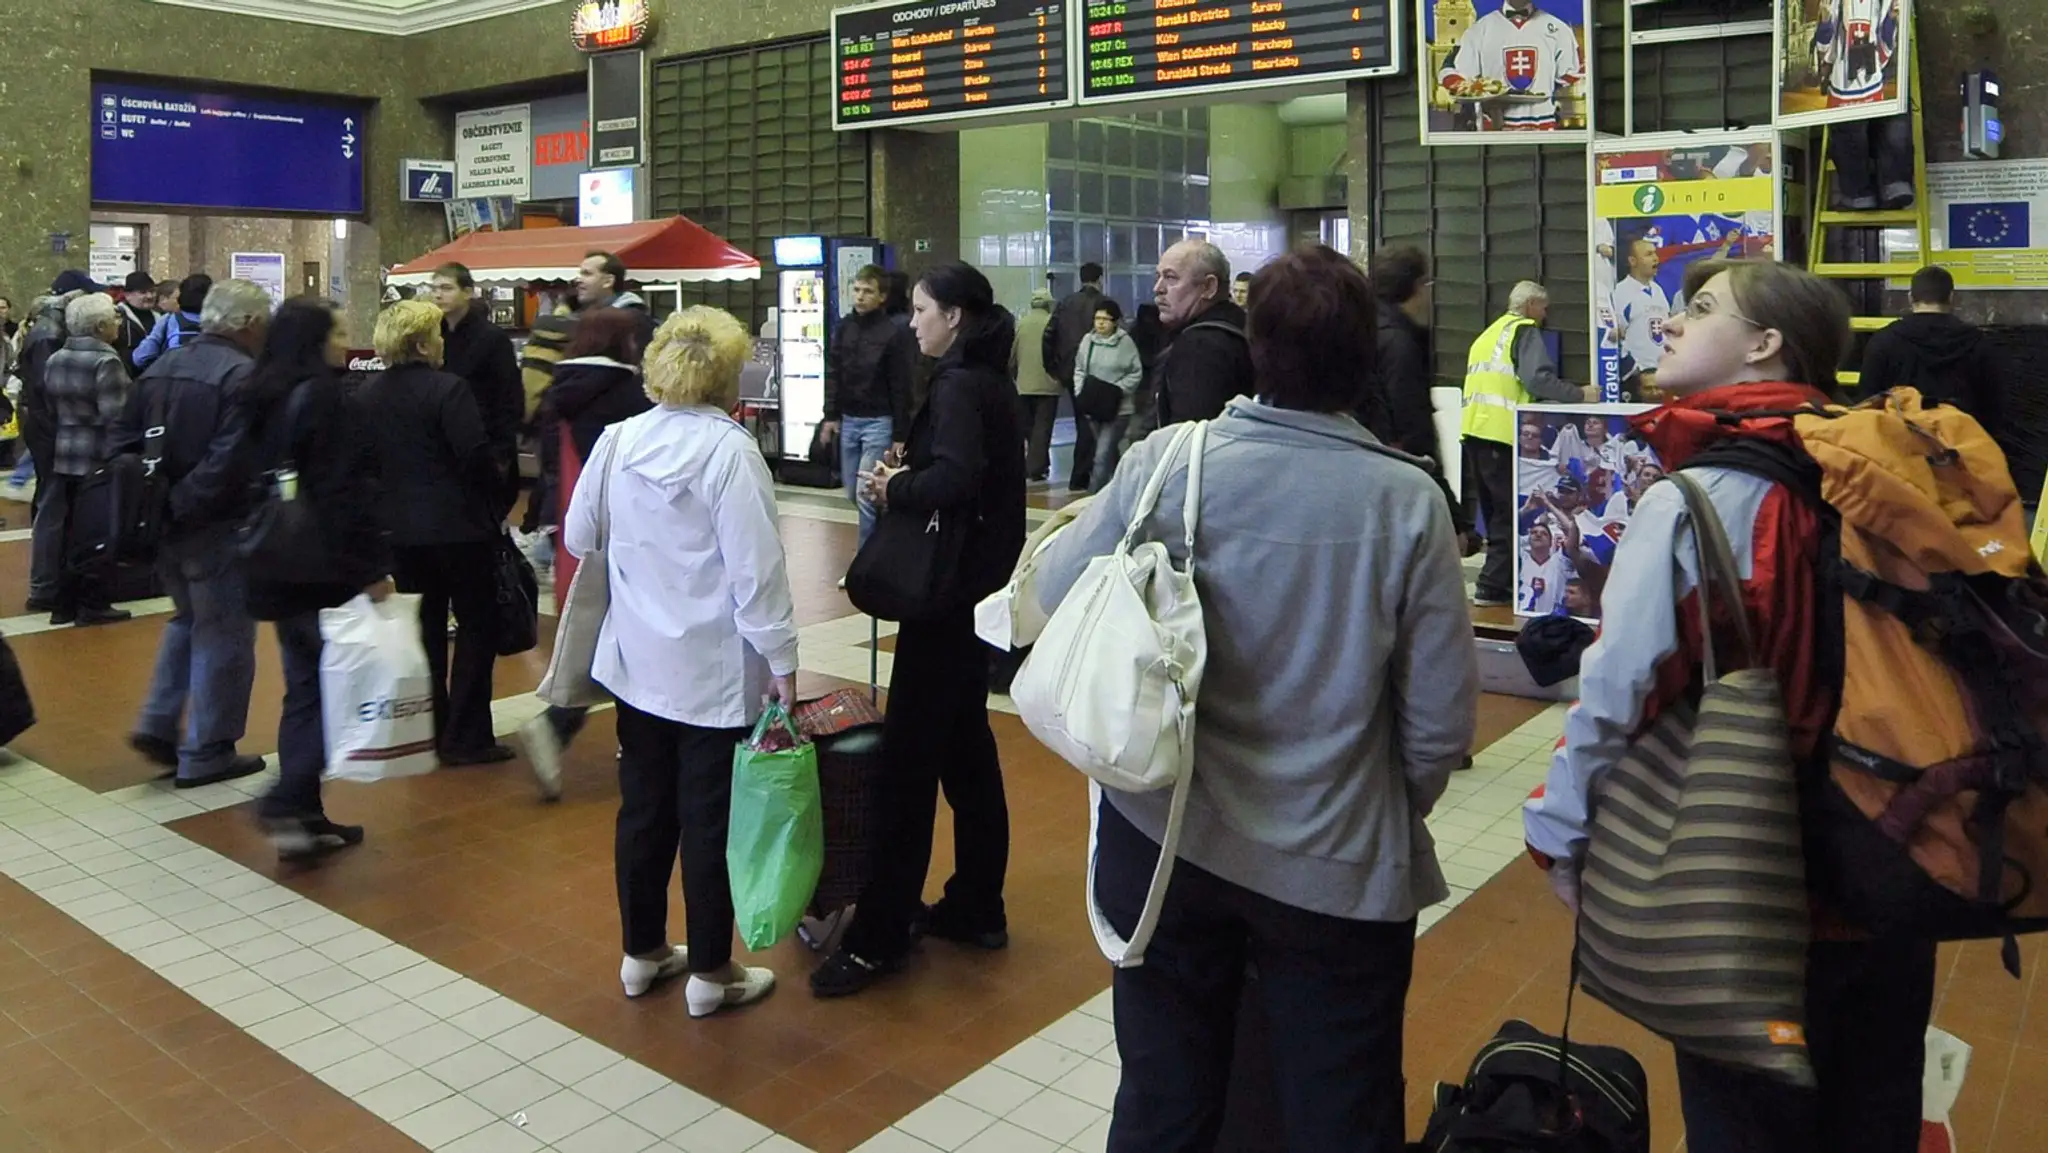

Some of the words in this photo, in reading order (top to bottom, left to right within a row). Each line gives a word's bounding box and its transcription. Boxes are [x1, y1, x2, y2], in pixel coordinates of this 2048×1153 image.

[892, 7, 933, 22] ODCHODY
[940, 0, 997, 15] DEPARTURES
[1351, 8, 1360, 21] 4
[1037, 16, 1046, 26] 3
[1113, 21, 1123, 33] R
[1155, 13, 1189, 28] Banská
[1190, 7, 1231, 23] Bystrica
[1037, 33, 1046, 44] 2
[1039, 50, 1046, 60] 1
[1352, 47, 1361, 60] 5
[1115, 55, 1135, 68] REX
[1037, 67, 1046, 77] 2
[1038, 83, 1046, 94] 4
[121, 114, 146, 124] BUFET
[121, 128, 135, 138] WC
[462, 121, 523, 139] OBČERSTVENIE
[535, 120, 589, 166] HERŇ
